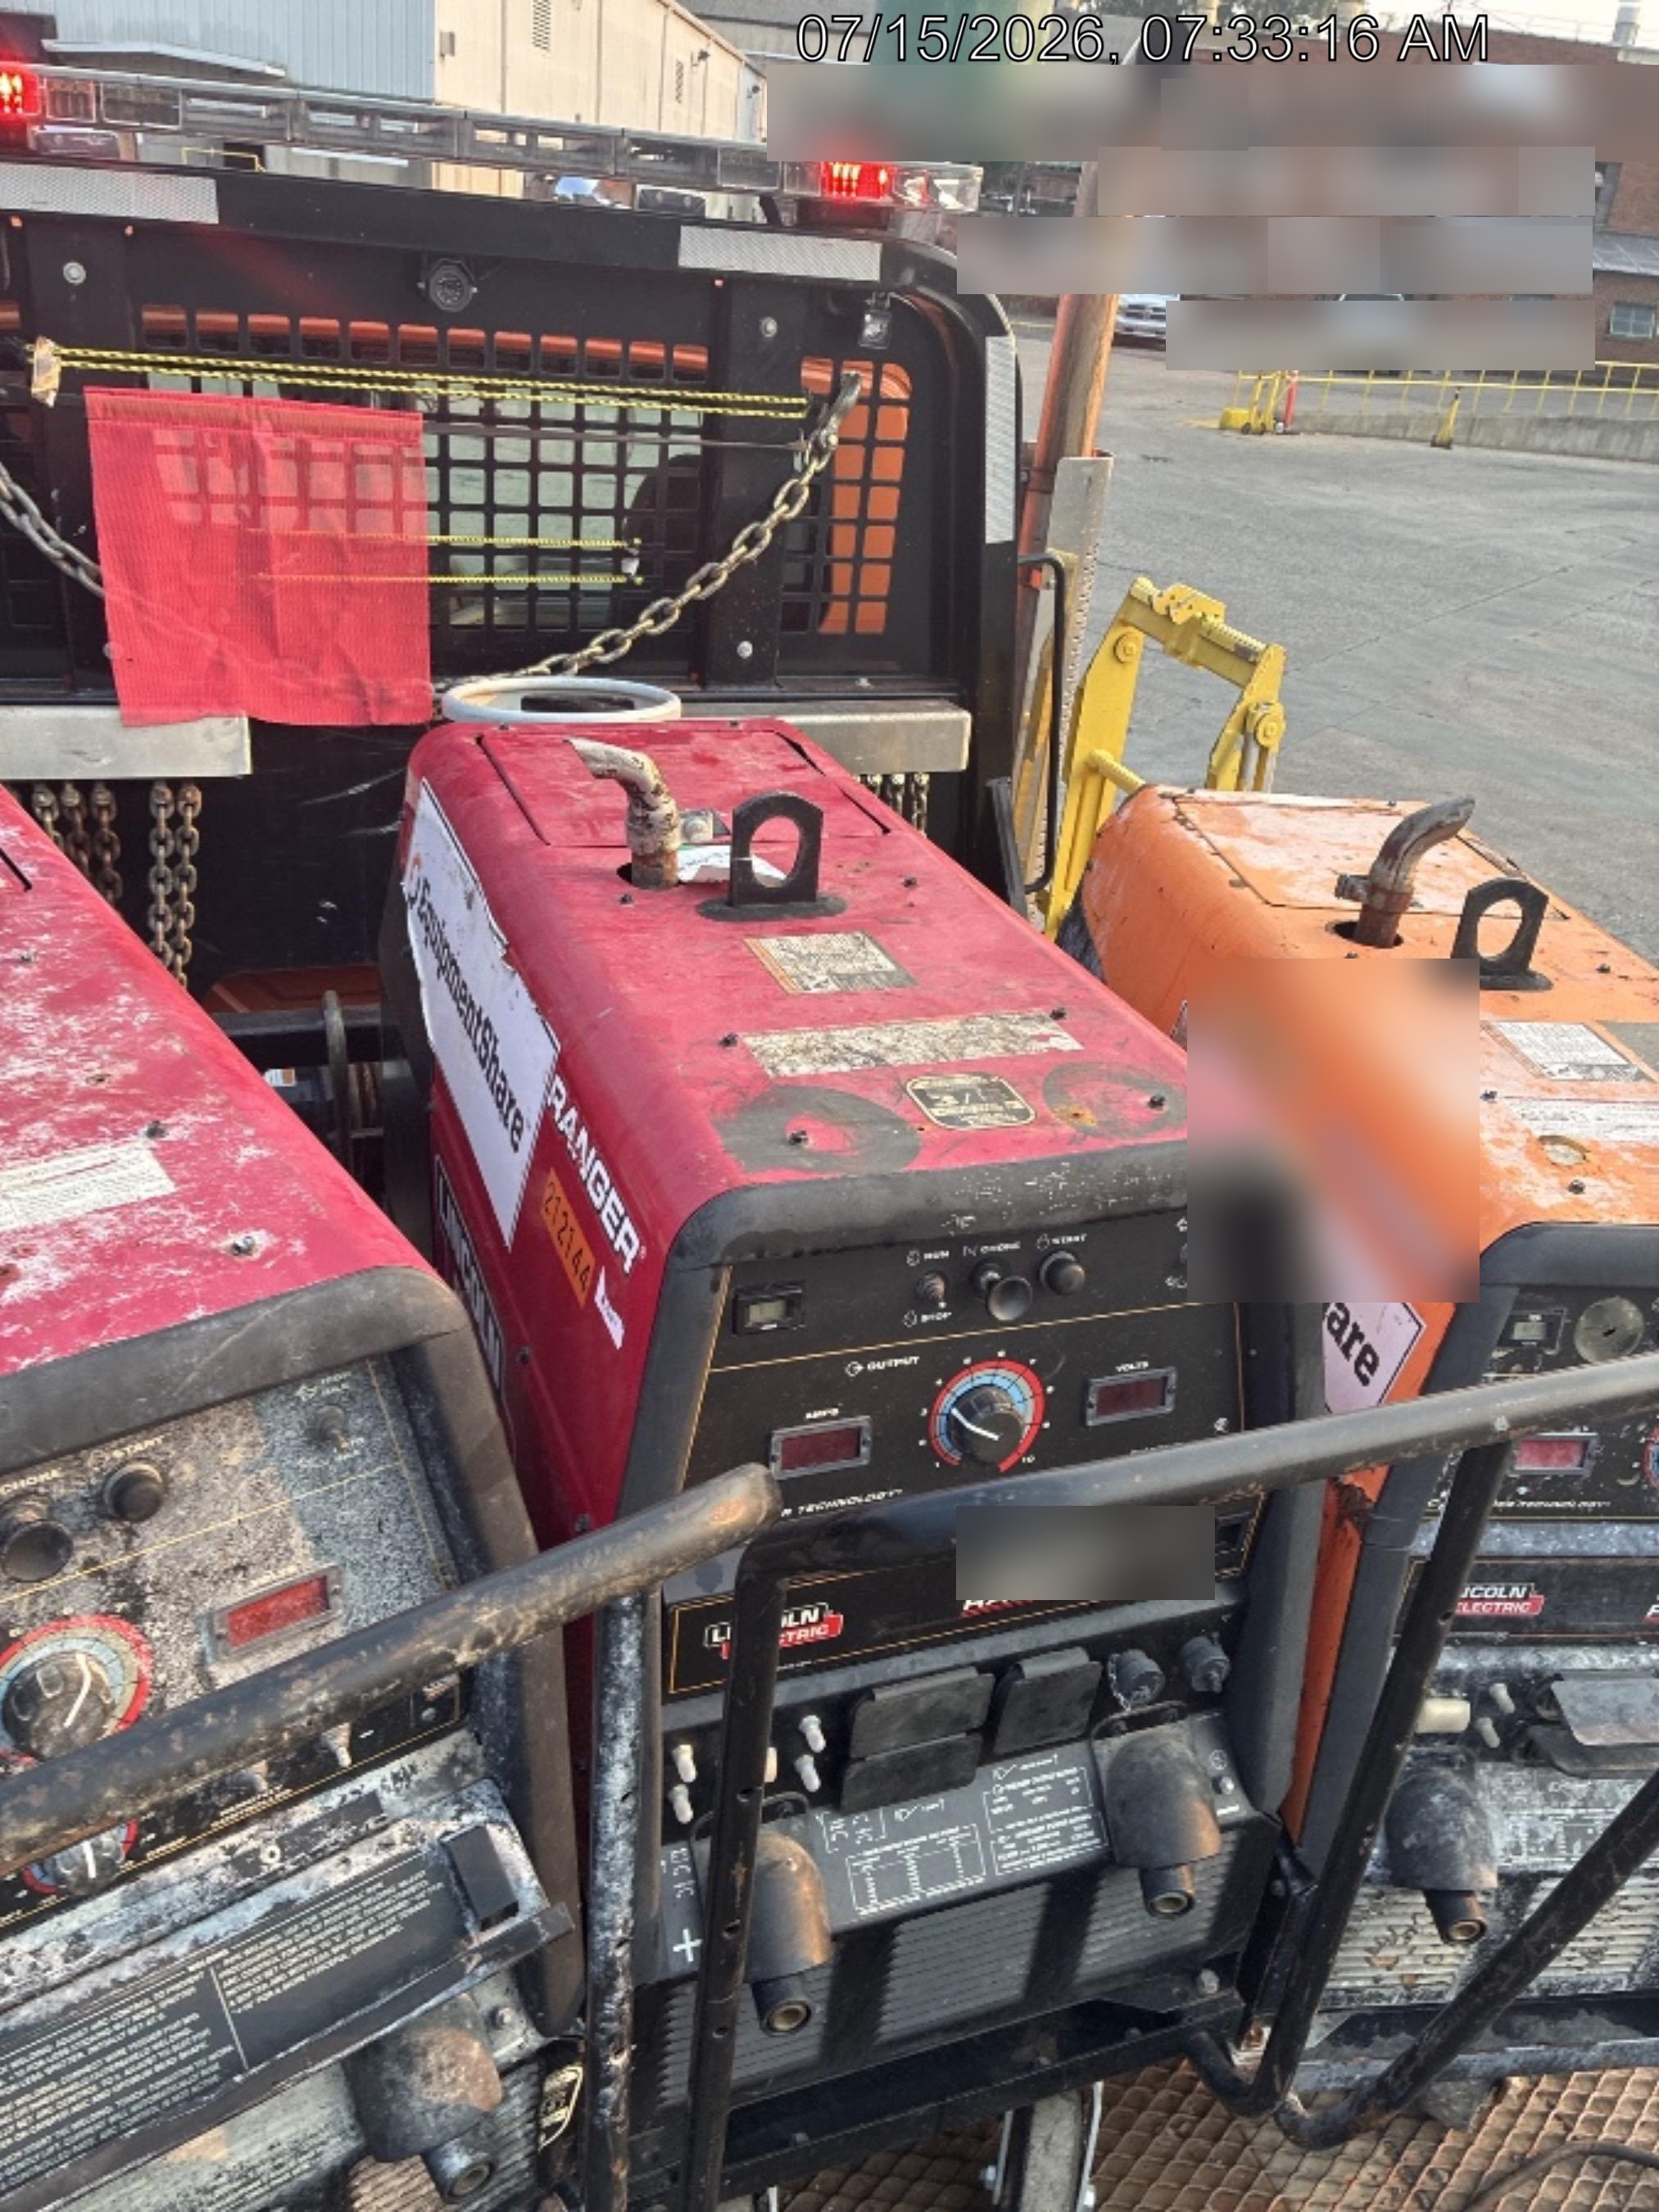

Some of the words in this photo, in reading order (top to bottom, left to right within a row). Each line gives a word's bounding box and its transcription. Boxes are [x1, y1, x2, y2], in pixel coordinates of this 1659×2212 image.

[417, 877, 524, 1154] EquipmentShare
[547, 1073, 641, 1274] RANGER
[867, 1356, 921, 1372] OUTPUT
